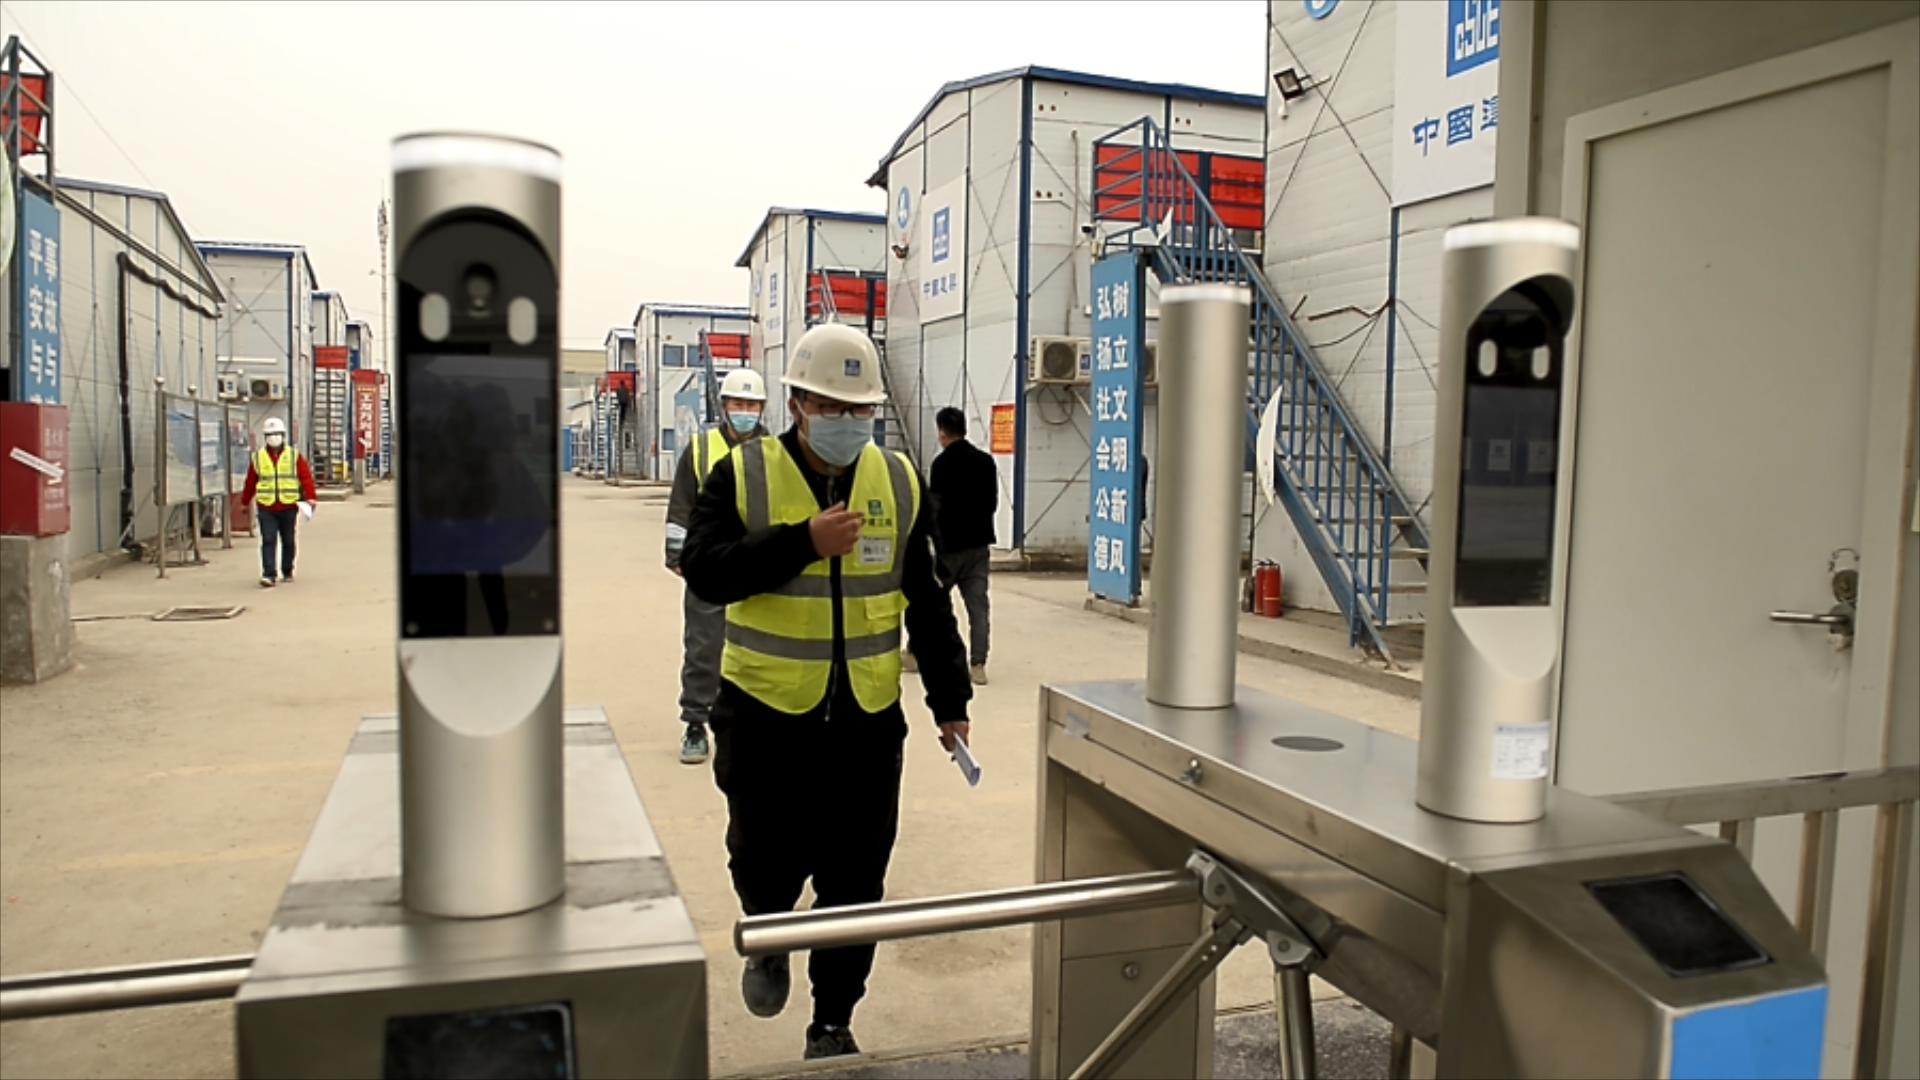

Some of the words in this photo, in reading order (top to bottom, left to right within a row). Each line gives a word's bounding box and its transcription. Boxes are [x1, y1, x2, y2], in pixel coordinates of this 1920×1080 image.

[44, 236, 58, 404] 事故与
[1094, 285, 1112, 571] 弘扬社会公德
[1109, 280, 1129, 576] 树立文明新风
